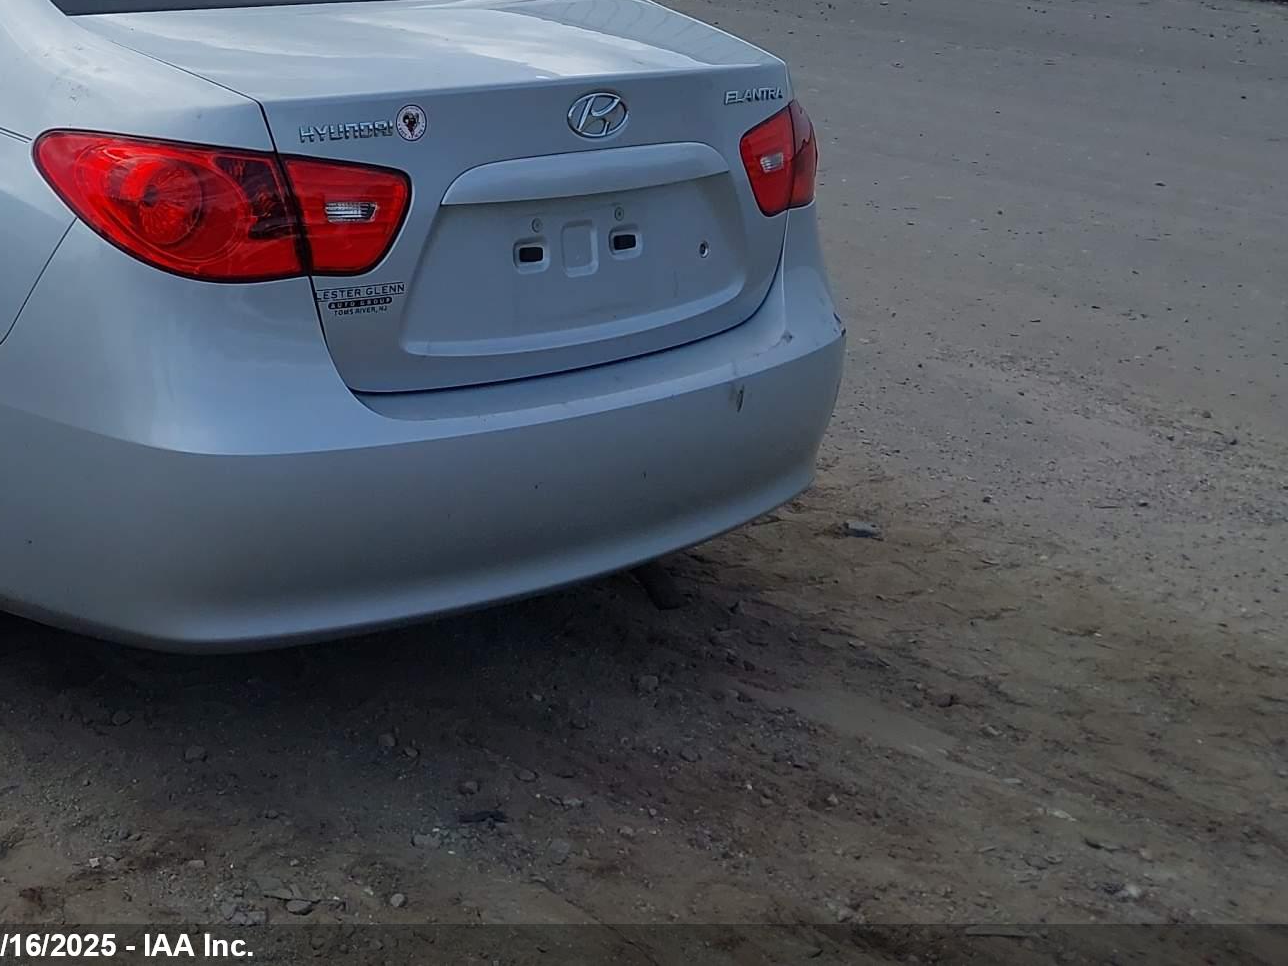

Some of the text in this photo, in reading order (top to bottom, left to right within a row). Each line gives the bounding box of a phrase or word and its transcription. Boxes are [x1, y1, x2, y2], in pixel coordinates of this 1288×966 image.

[723, 87, 783, 105] ELANTRA
[299, 120, 393, 143] HYUNDAI
[315, 284, 405, 300] LESTER GLENN
[359, 296, 391, 305] GROUP
